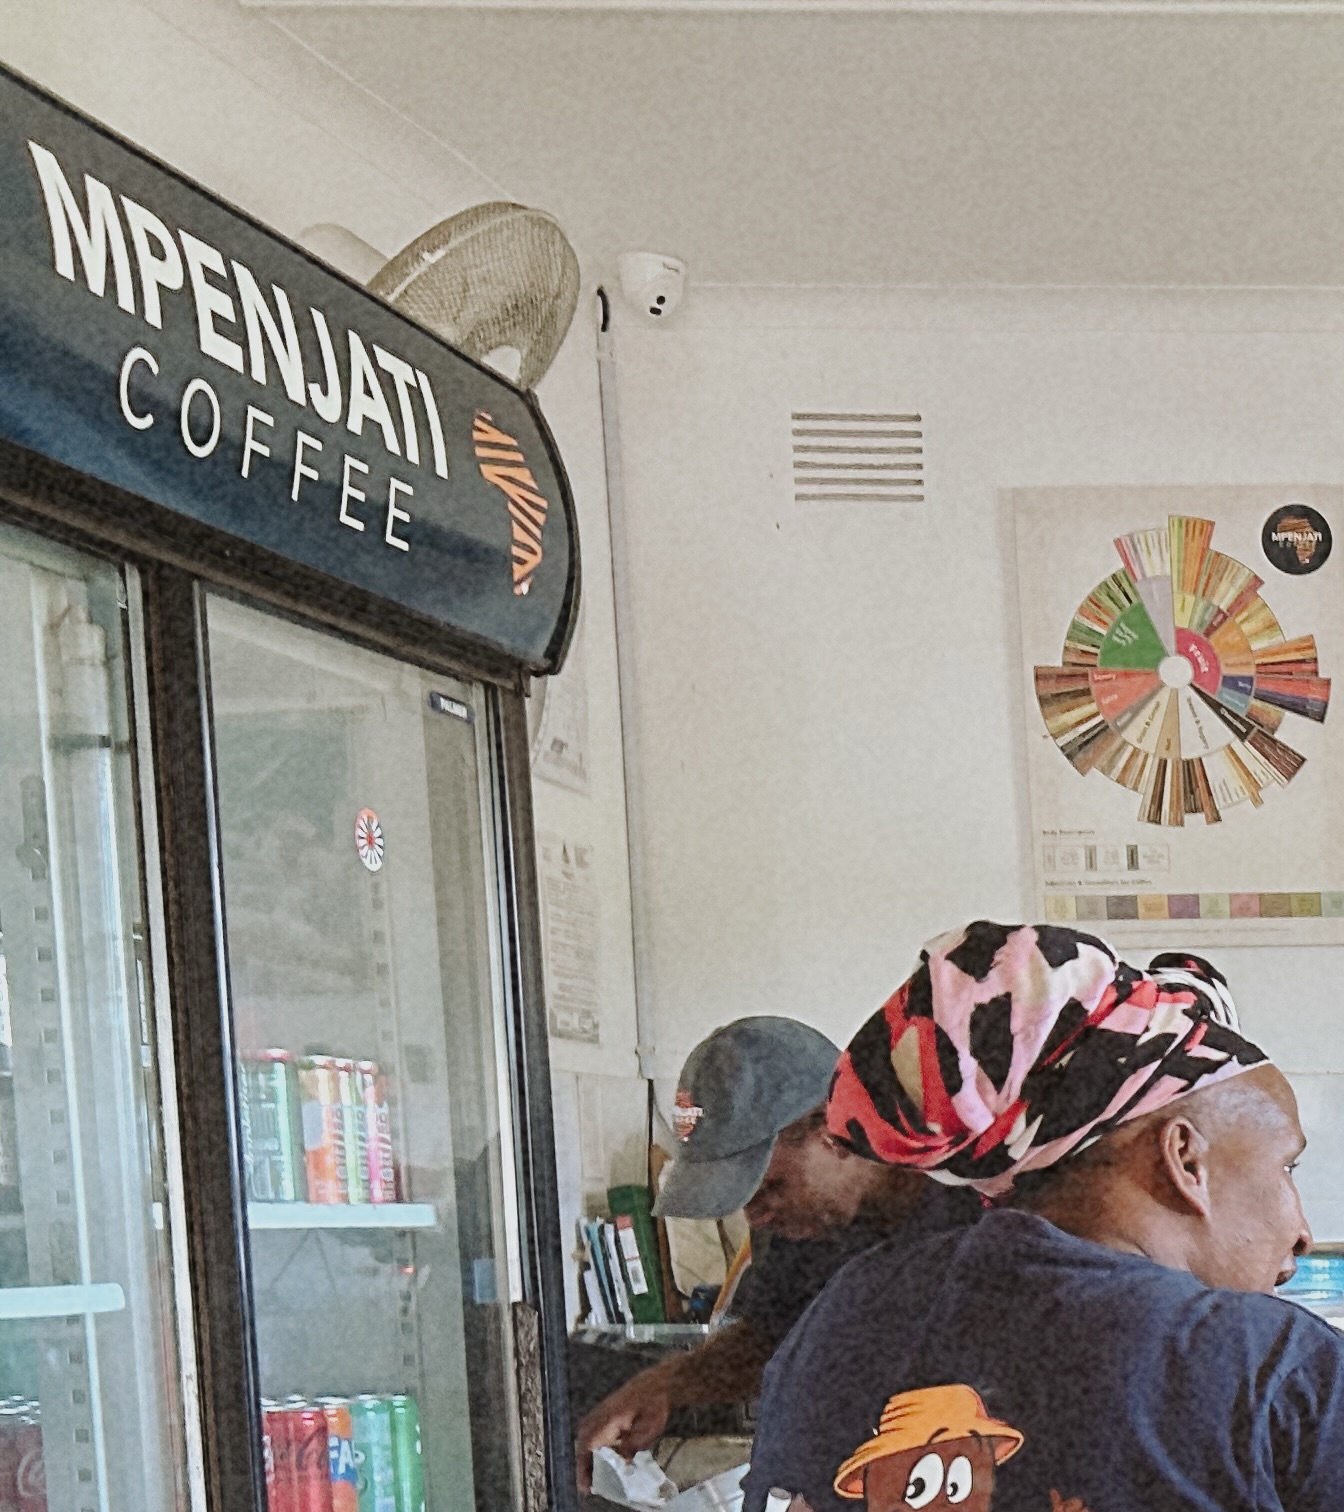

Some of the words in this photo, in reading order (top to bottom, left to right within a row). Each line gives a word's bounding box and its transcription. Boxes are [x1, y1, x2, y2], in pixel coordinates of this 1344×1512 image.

[28, 139, 449, 480] MPENJATI
[119, 346, 414, 552] COFFEE
[1271, 532, 1322, 542] MPENJATI
